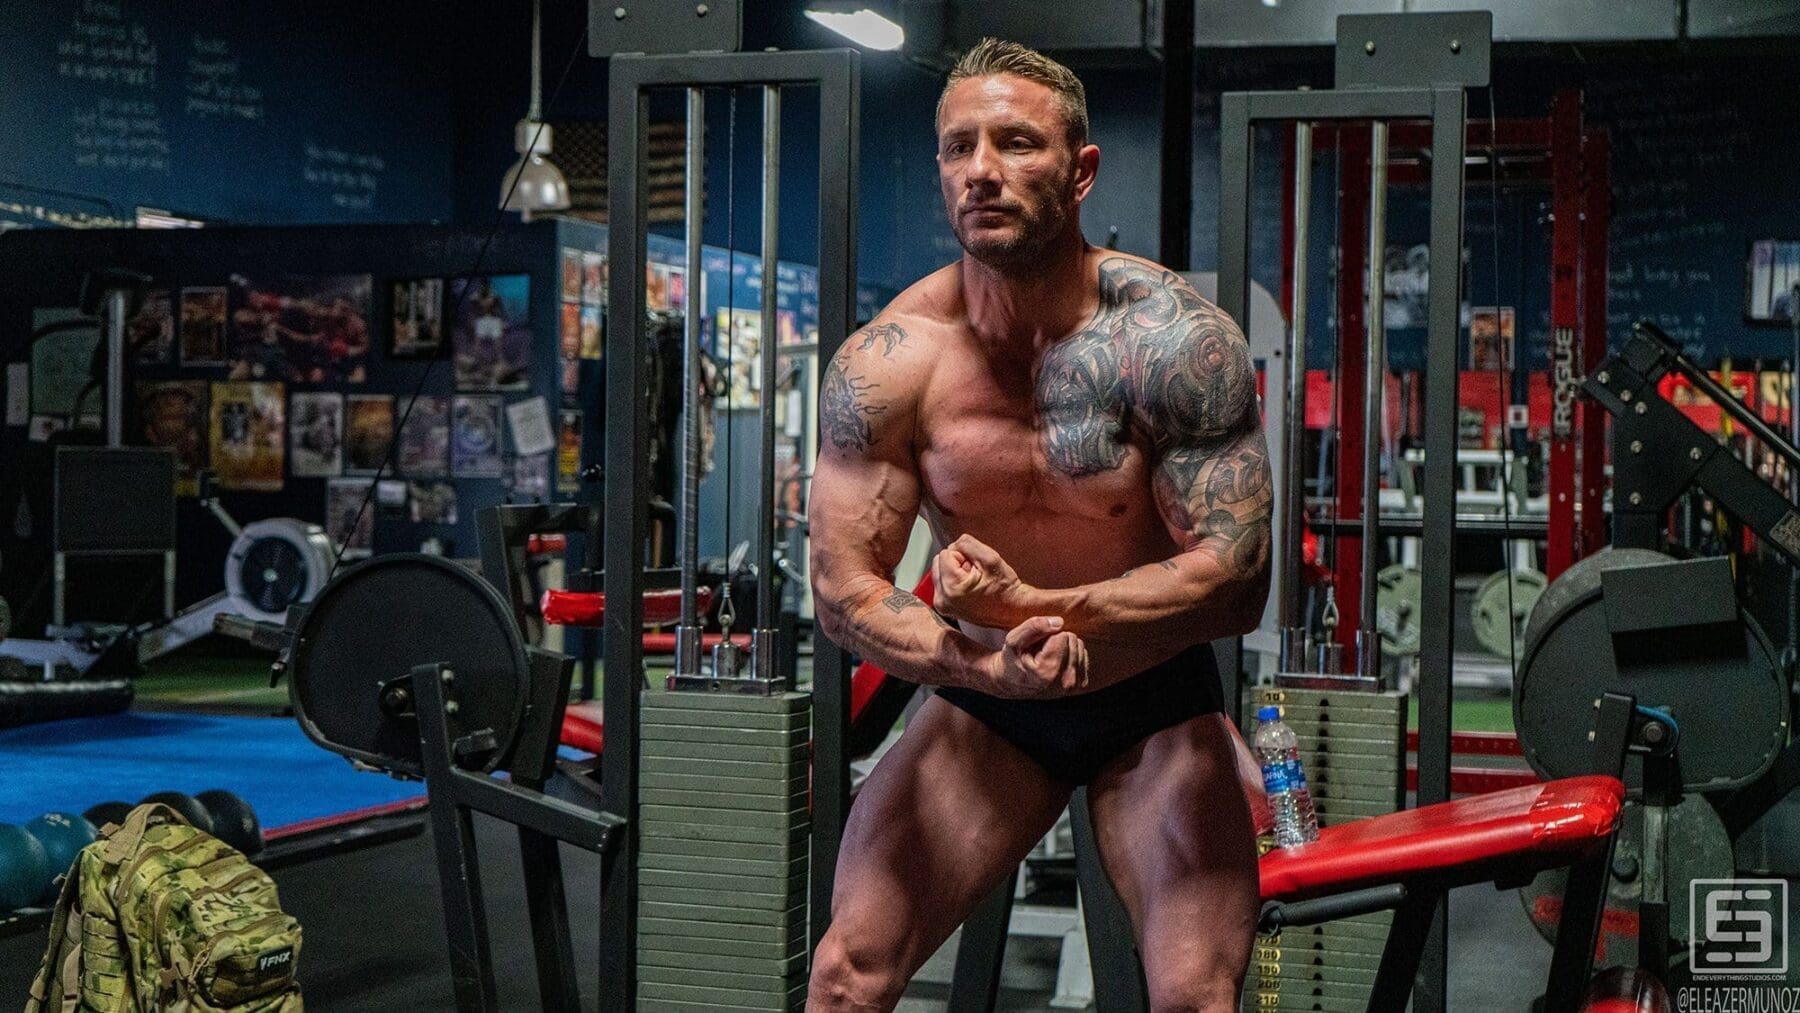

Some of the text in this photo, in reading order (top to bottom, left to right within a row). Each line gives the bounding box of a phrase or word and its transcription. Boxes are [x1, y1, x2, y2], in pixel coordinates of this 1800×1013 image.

[1554, 328, 1574, 432] ROGUE
[1265, 692, 1280, 701] 10
[1257, 950, 1278, 959] 180
[1257, 965, 1278, 974] 190
